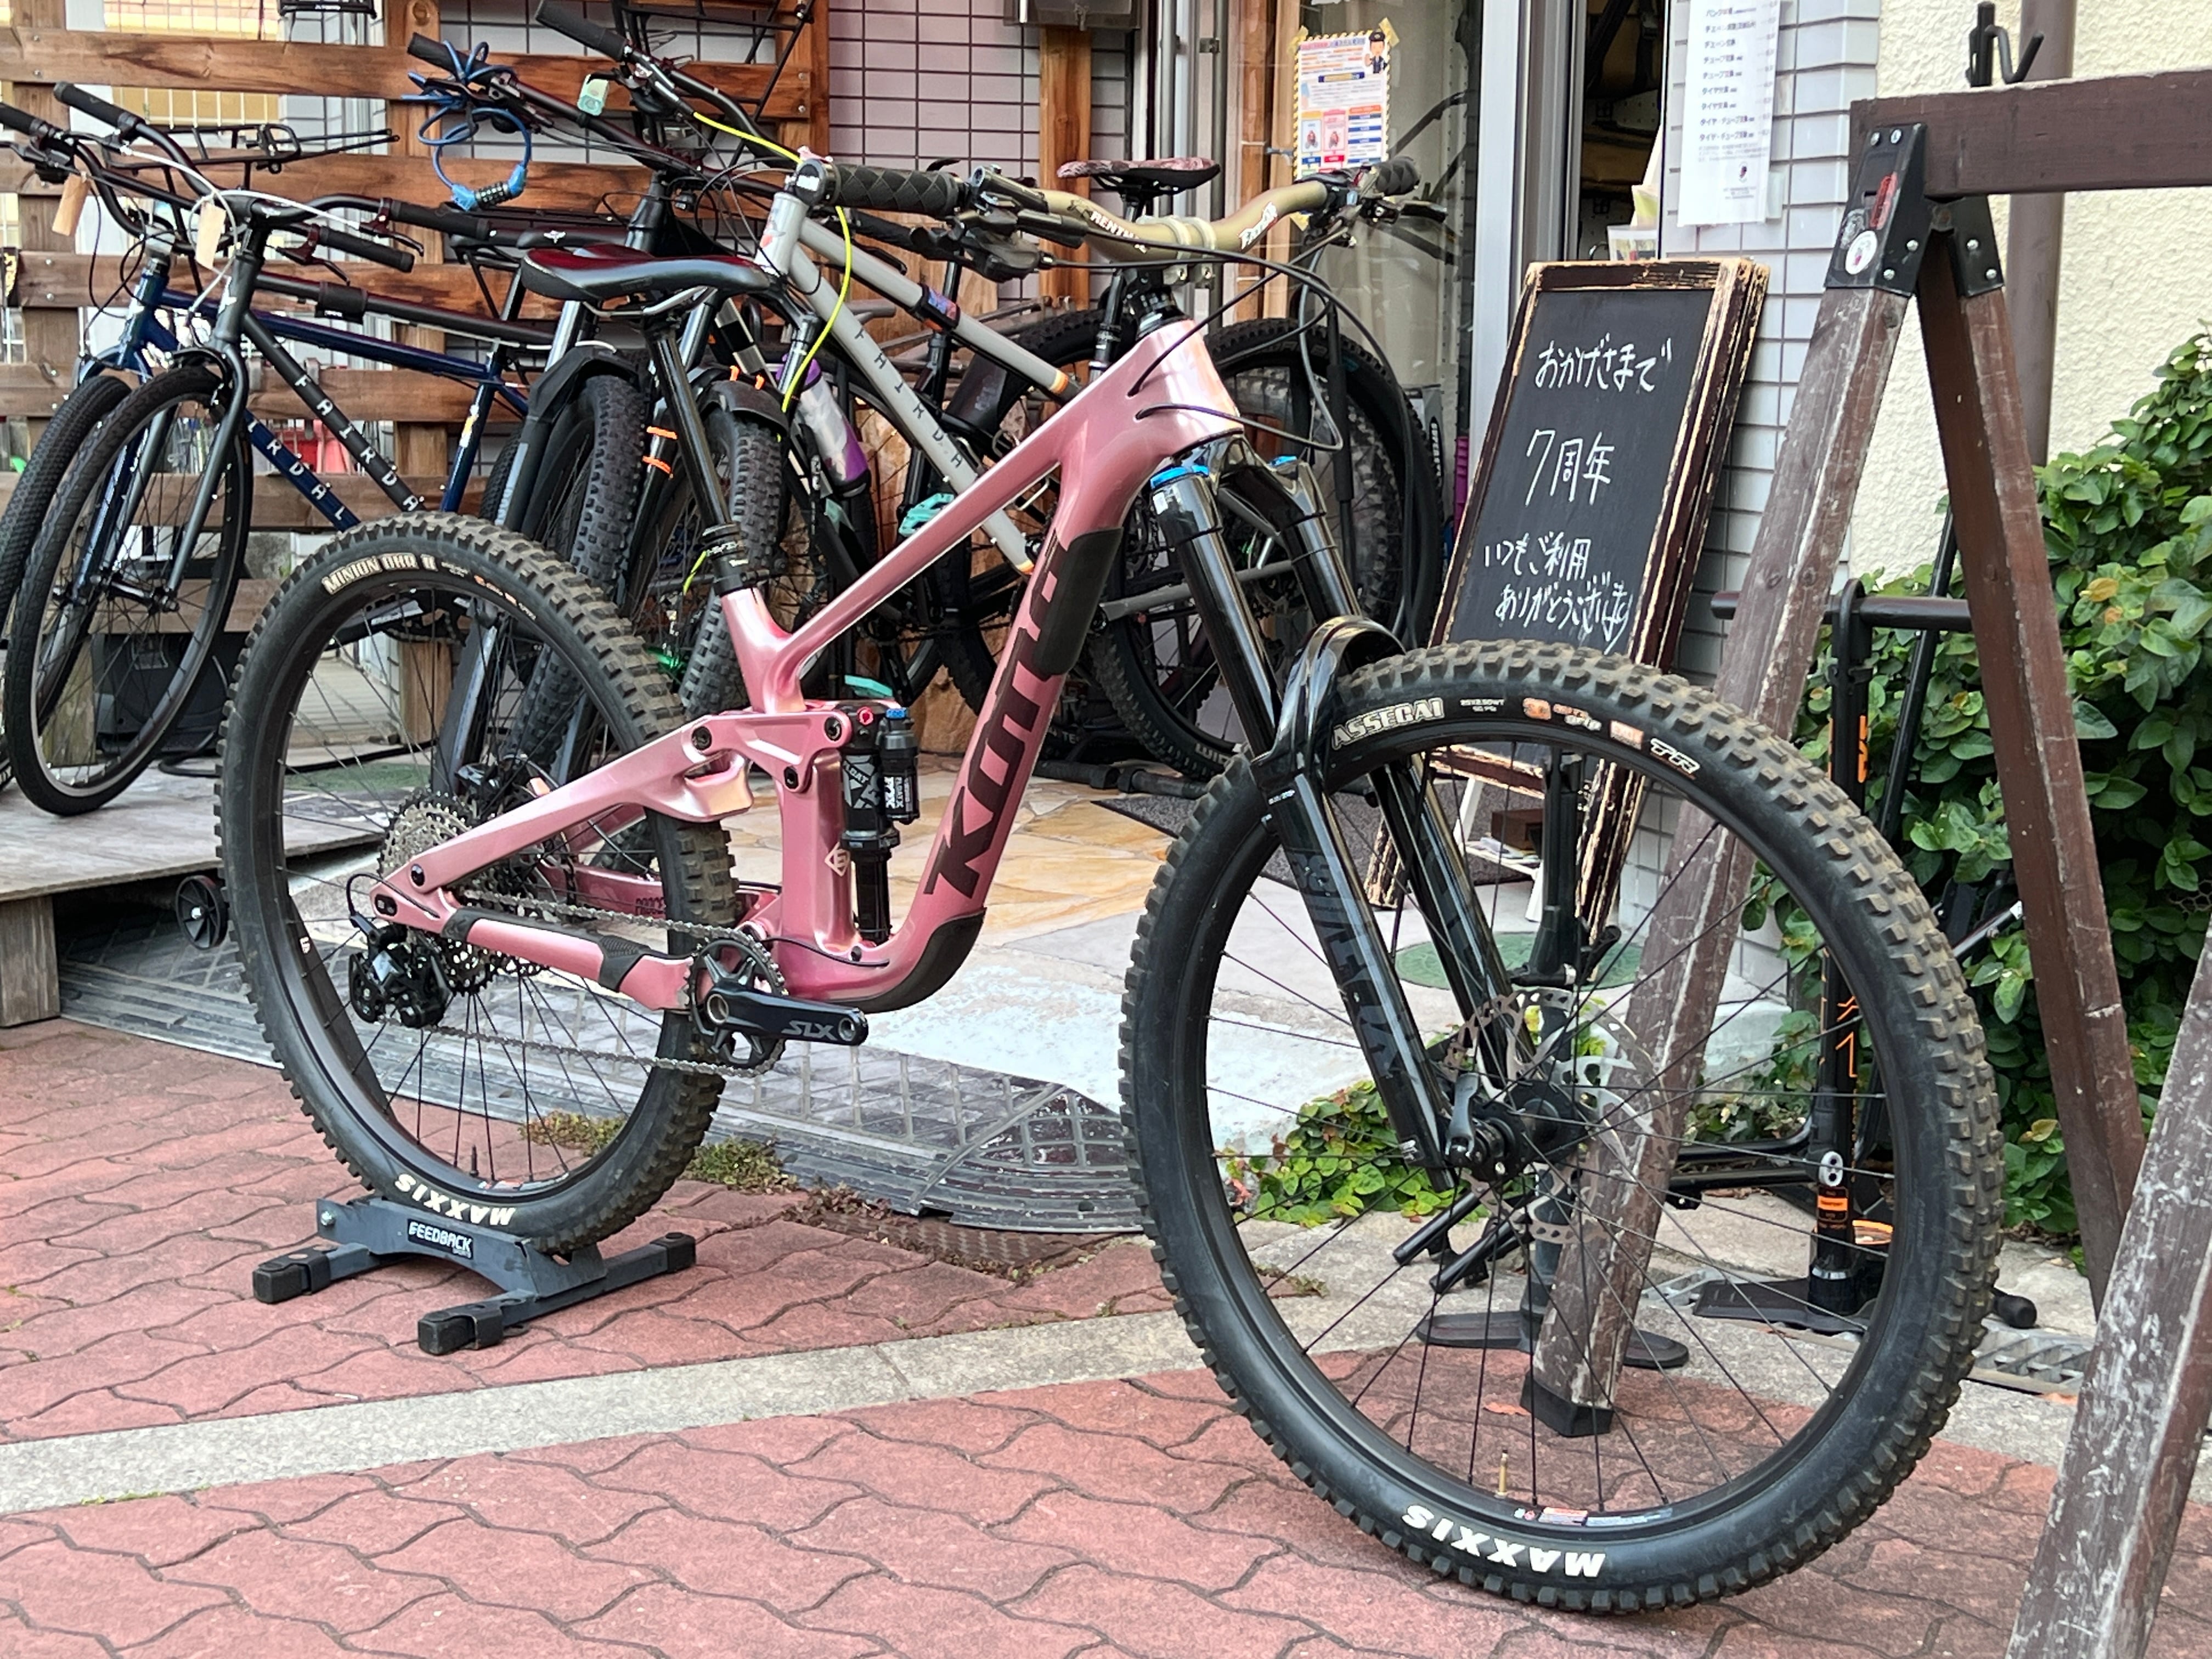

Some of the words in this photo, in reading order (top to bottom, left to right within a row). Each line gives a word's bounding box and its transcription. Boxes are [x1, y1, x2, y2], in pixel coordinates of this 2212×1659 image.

[1536, 333, 1671, 392] おかげさまで
[1525, 430, 1615, 506] 7周年
[1495, 571, 1633, 655] ありがとうございます
[1331, 697, 1444, 750] ASSEGAI
[781, 1020, 838, 1041] SLX
[394, 1173, 516, 1225] MAXXIS
[409, 1221, 472, 1252] FEEDBACK
[1402, 1505, 1606, 1577] MAXXIS
